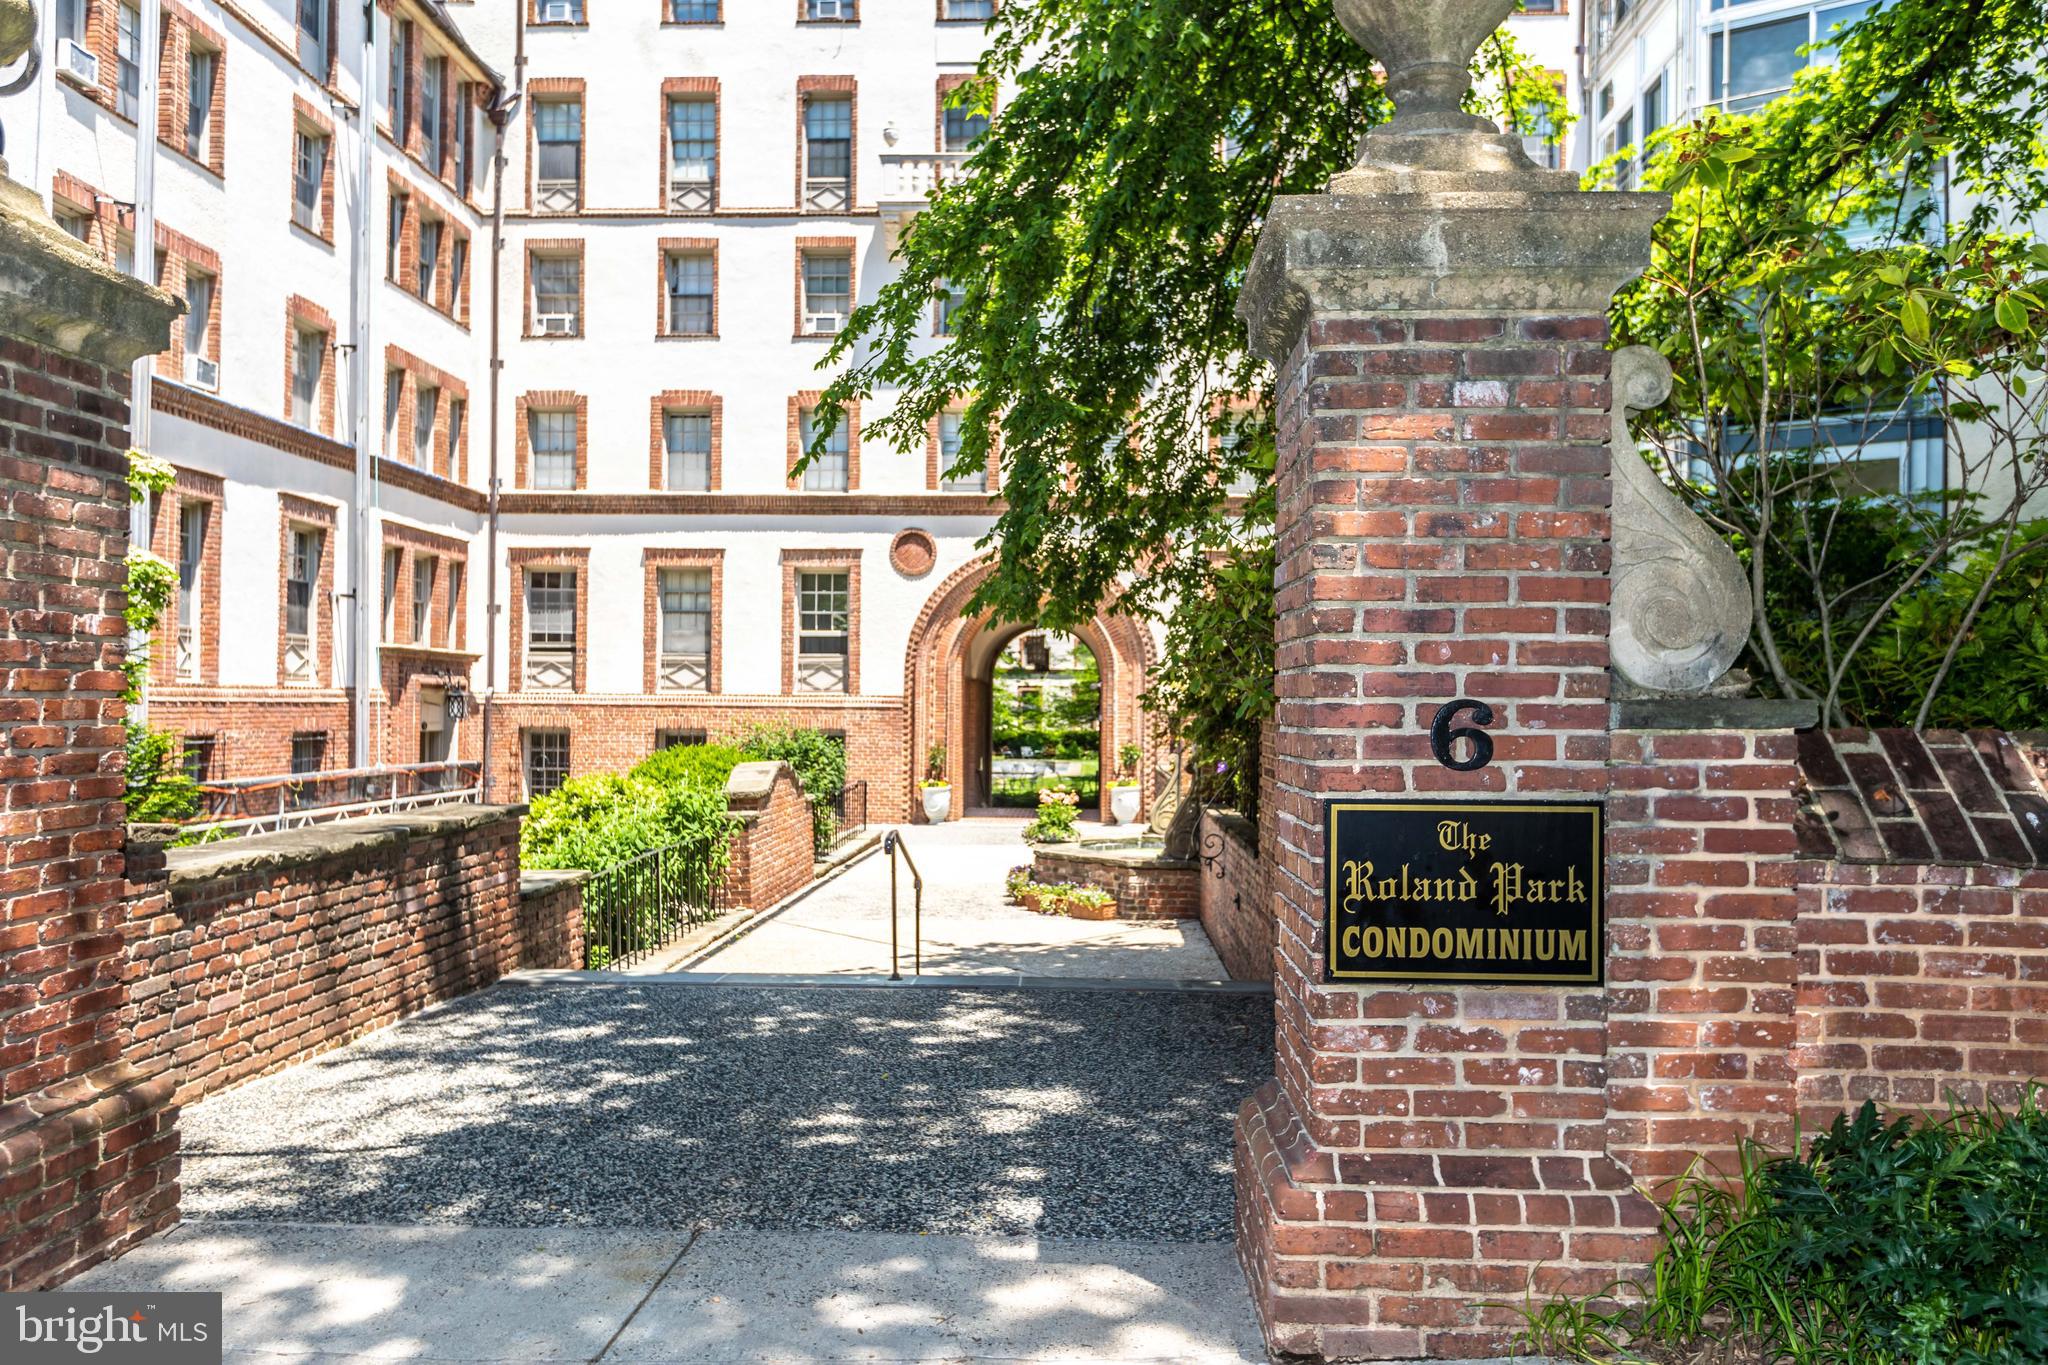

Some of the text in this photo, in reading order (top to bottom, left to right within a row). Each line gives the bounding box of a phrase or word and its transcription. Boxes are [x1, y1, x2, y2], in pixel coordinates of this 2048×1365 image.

[1430, 698, 1494, 772] 6
[1437, 820, 1492, 860] The
[1342, 860, 1588, 916] Roland Park
[1342, 925, 1587, 962] CONDOMINIUM
